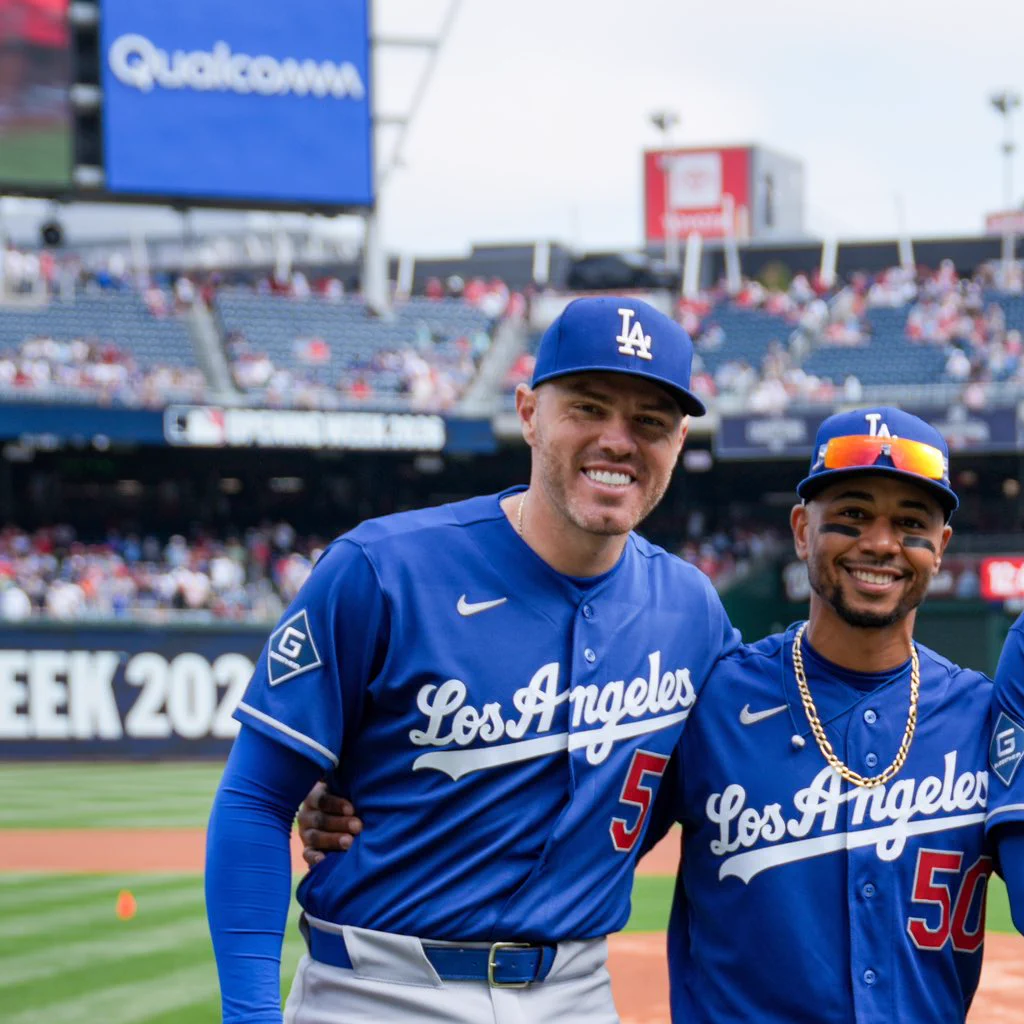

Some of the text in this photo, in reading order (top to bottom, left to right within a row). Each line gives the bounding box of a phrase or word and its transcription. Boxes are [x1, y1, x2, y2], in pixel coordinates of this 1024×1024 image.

[108, 33, 366, 100] Qualcomm
[616, 308, 653, 360] LA
[278, 626, 306, 658] G
[408, 650, 697, 765] Los Angeles
[609, 749, 671, 851] 5
[706, 783, 787, 856] Los
[907, 848, 993, 953] 50
